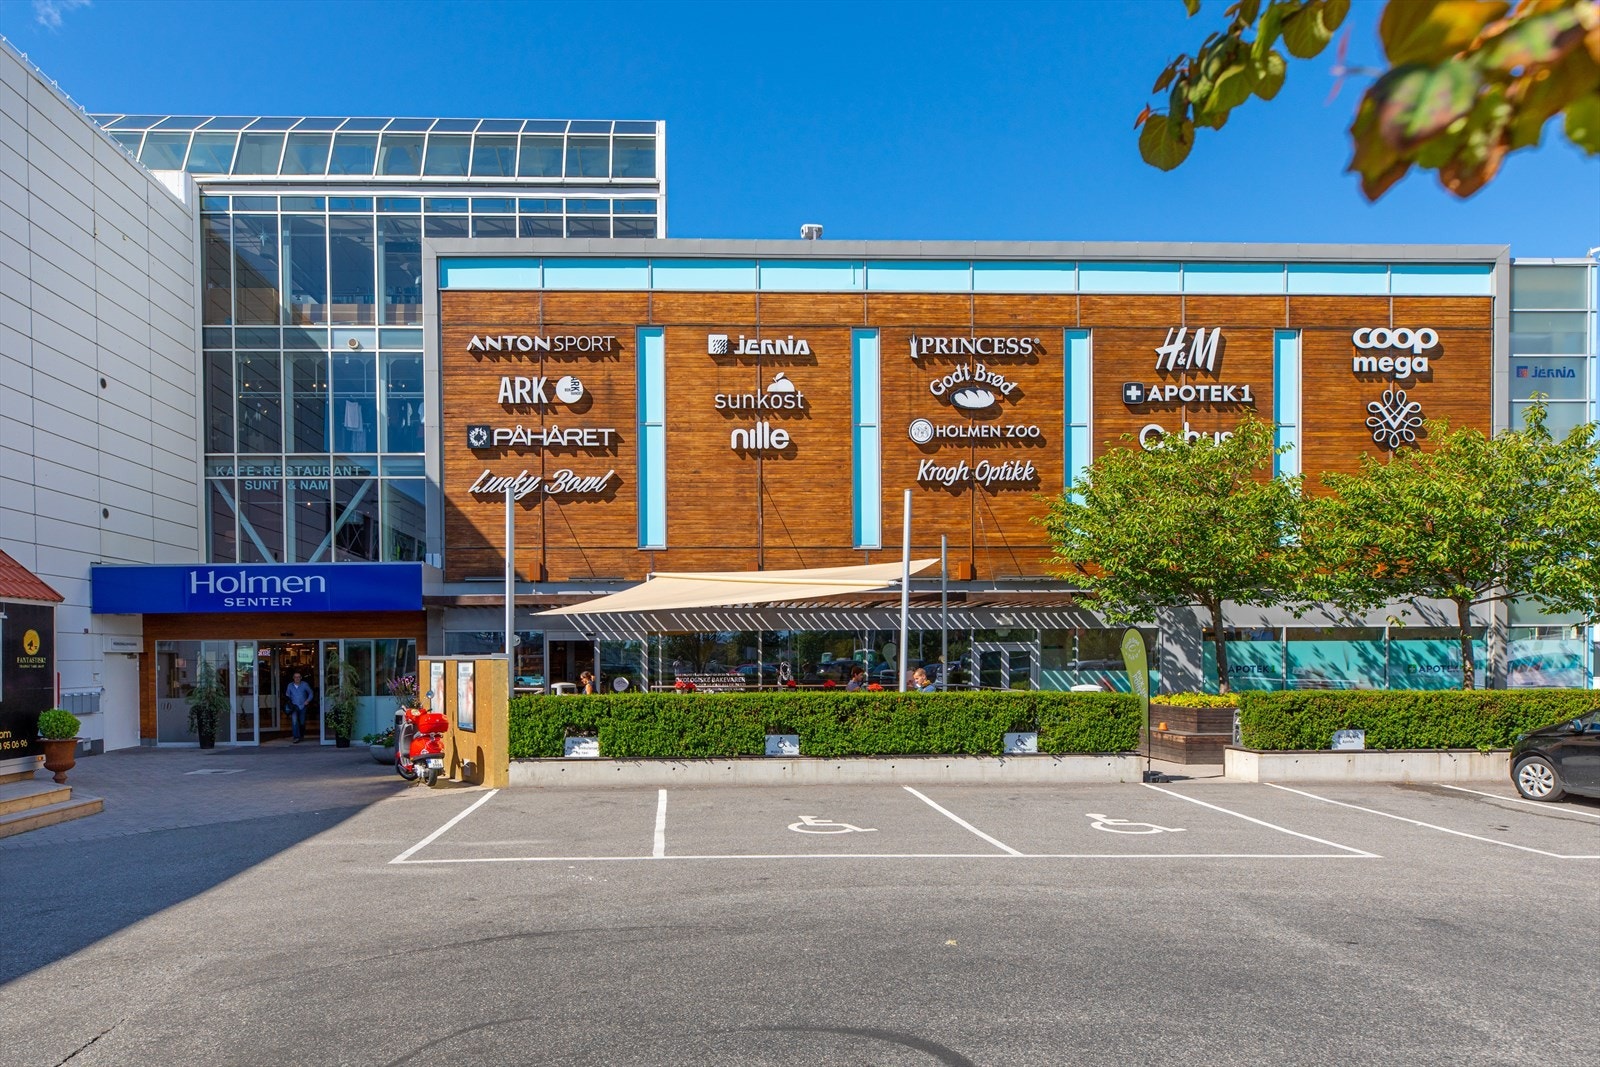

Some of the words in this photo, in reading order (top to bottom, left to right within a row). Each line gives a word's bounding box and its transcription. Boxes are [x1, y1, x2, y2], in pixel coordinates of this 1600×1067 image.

[1154, 327, 1221, 372] H&M
[1352, 327, 1439, 354] coop
[929, 363, 971, 396] Godt
[974, 363, 1018, 395] Brød
[1353, 356, 1429, 379] mega
[497, 376, 549, 404] ARK
[714, 388, 804, 409] sunkost
[493, 424, 616, 446] PÅHÅRET
[731, 421, 790, 450] nille
[936, 425, 1001, 438] HOLMEN
[1006, 425, 1041, 438] ZOO
[1139, 421, 1235, 451] Cbu
[244, 480, 280, 491] SUNT
[287, 480, 297, 490] &
[300, 480, 329, 490] NAM
[468, 469, 542, 500] Lucky
[544, 469, 615, 494] Bowl
[917, 459, 970, 487] Krogh
[975, 459, 1035, 487] Optikk
[190, 570, 326, 594] Holmen
[224, 597, 293, 607] SENTER
[1228, 665, 1270, 674] APOTEK
